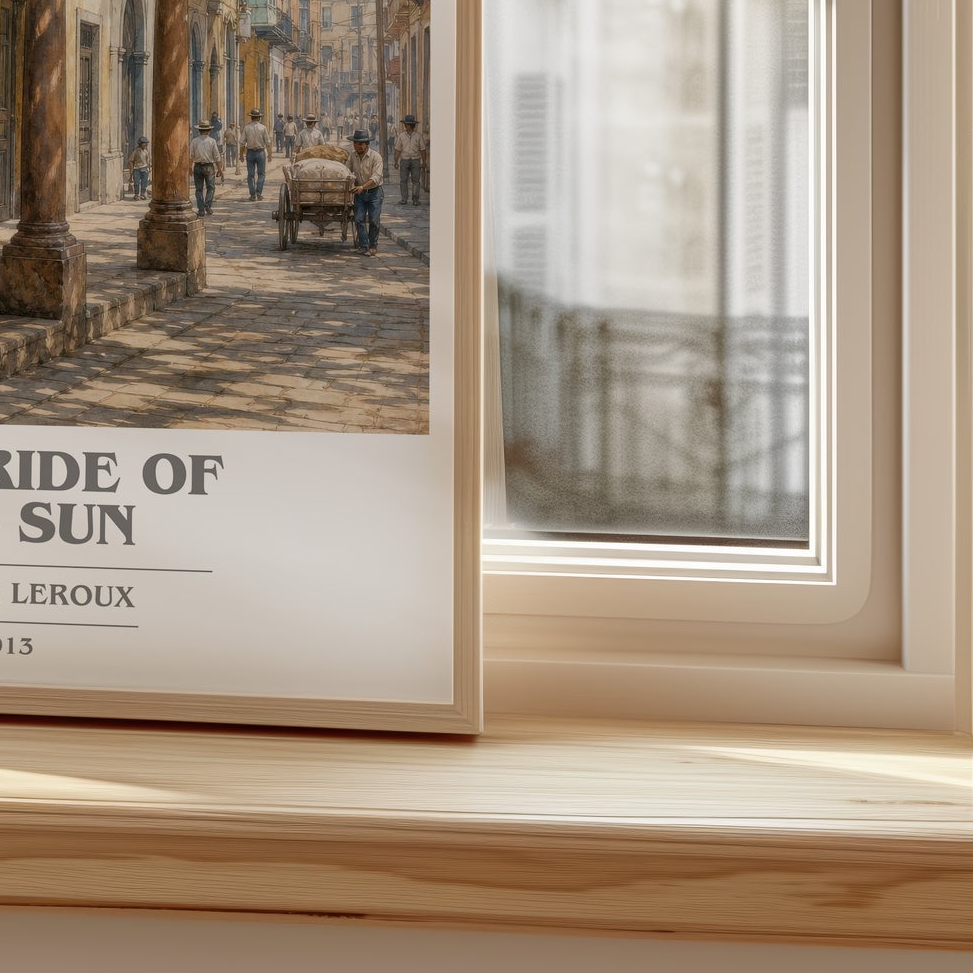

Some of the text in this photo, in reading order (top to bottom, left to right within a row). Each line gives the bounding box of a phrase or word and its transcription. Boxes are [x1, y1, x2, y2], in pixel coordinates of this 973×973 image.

[141, 452, 225, 496] OF
[18, 501, 137, 546] SUN
[11, 582, 136, 609] LEROUX
